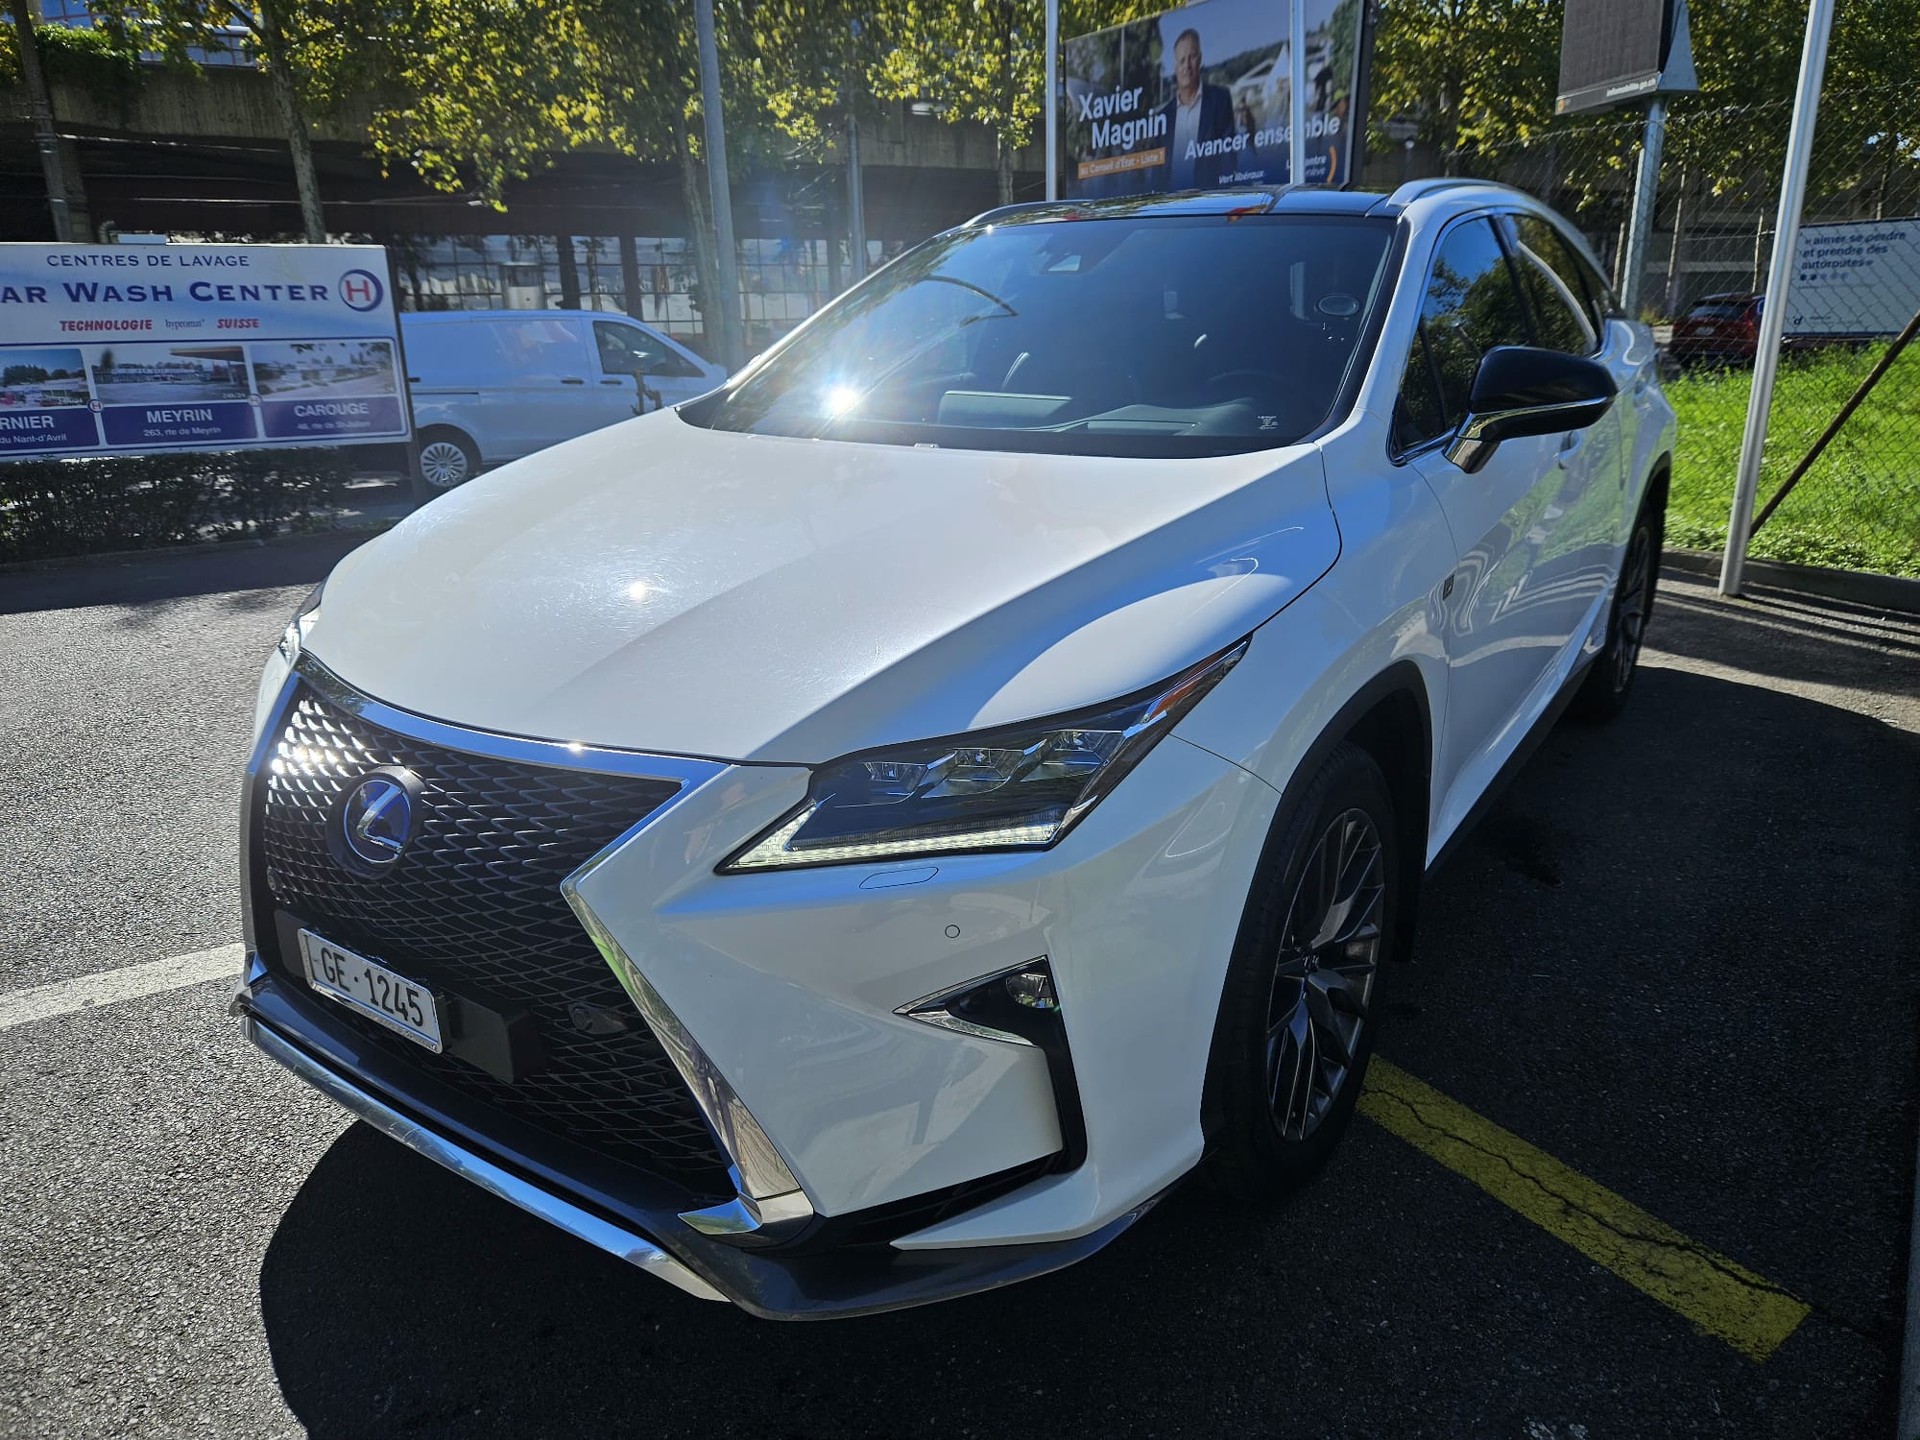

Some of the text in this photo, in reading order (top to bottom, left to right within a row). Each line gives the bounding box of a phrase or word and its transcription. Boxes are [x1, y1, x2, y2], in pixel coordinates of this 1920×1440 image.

[1079, 85, 1143, 122] Xavier
[1092, 109, 1167, 150] Magnin
[1184, 131, 1250, 161] Avancer
[1803, 249, 1814, 258] et
[47, 255, 250, 267] CENTRES DE LAVAGE
[59, 320, 152, 331] TECHNOLOGIE
[217, 318, 260, 329] SUISSE
[146, 409, 213, 423] MEYRIN
[294, 403, 369, 417] CAROUGE
[179, 428, 190, 436] de
